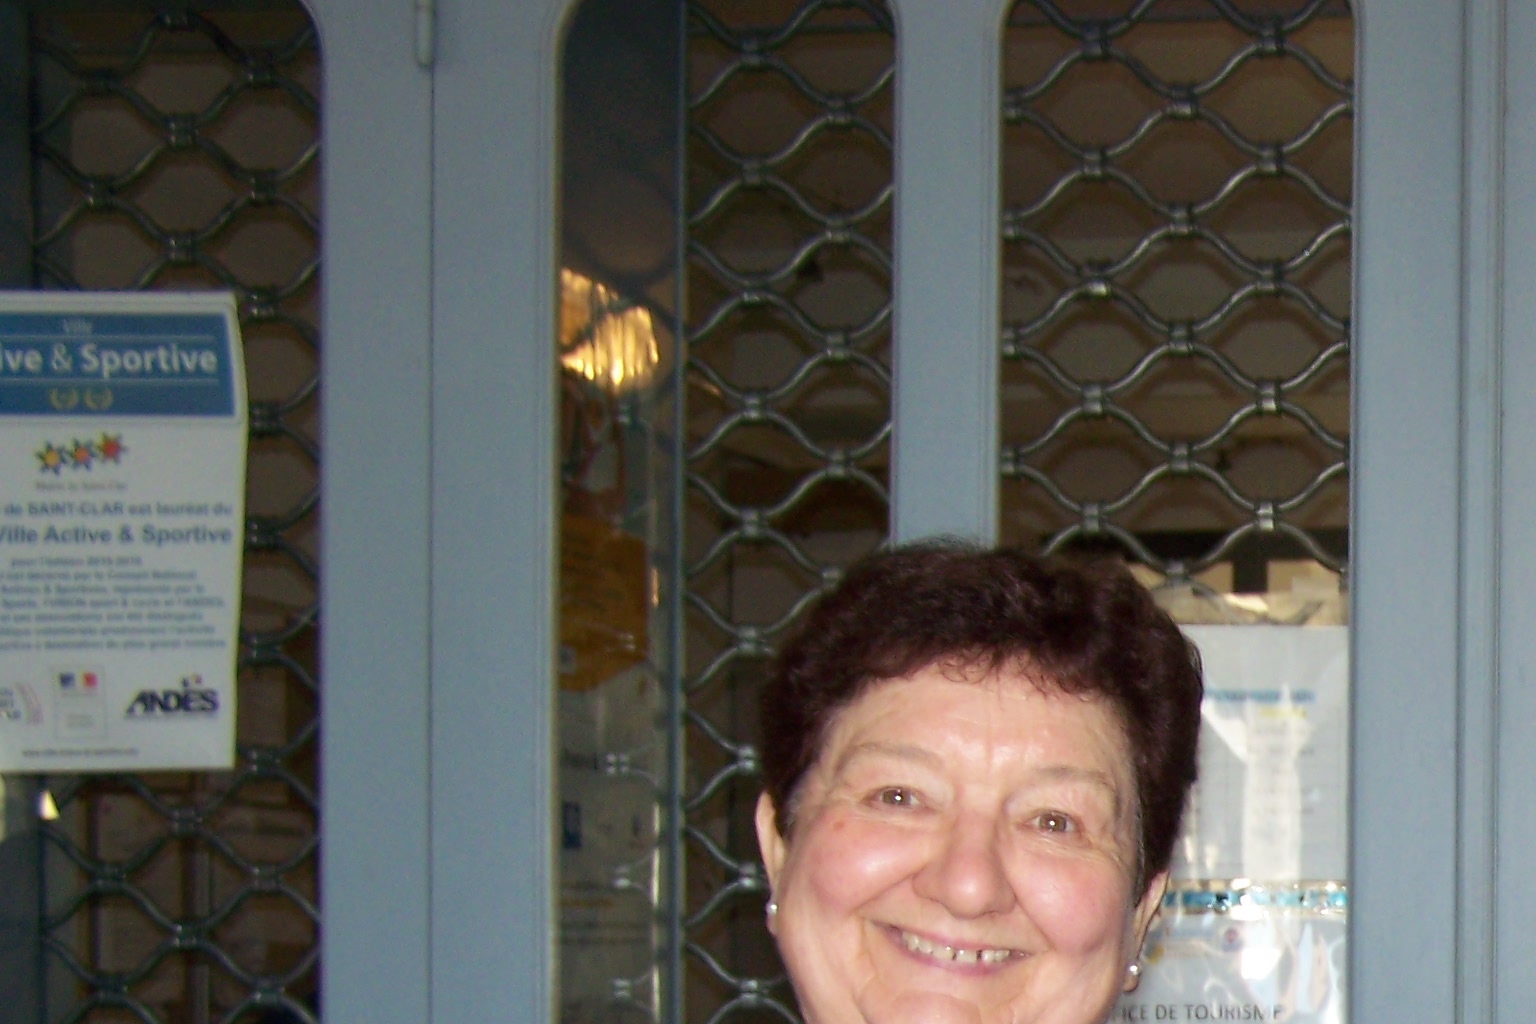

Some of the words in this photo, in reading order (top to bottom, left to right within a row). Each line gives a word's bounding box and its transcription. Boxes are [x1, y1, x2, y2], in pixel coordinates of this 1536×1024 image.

[52, 343, 73, 372] &
[81, 342, 218, 381] Sportive
[43, 524, 112, 544] Active
[118, 524, 135, 544] &
[142, 523, 232, 550] Sportive
[1155, 1004, 1177, 1021] DE
